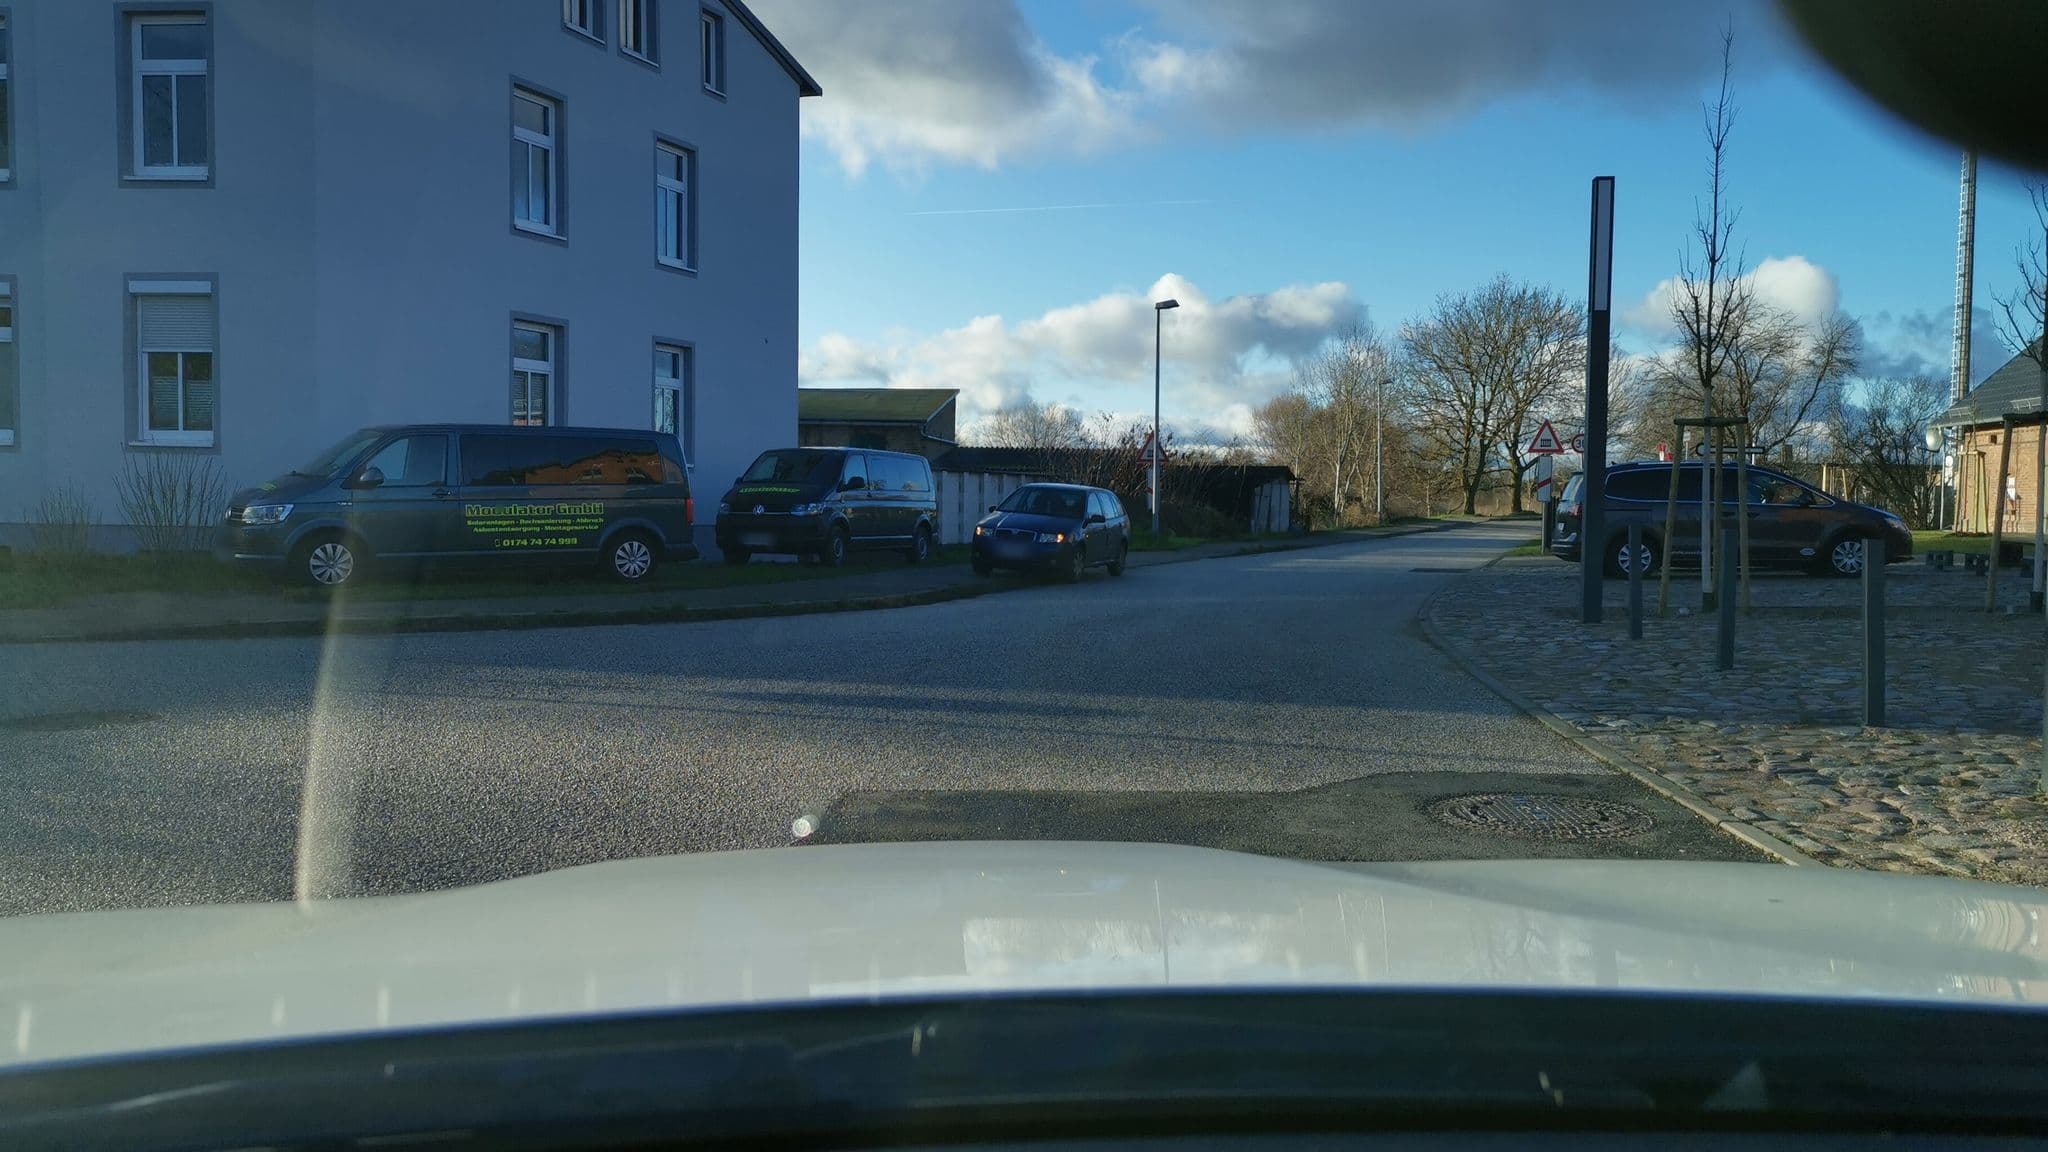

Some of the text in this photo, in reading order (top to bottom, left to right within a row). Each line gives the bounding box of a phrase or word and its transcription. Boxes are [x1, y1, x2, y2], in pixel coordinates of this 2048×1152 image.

[556, 503, 604, 515] GmbH
[529, 538, 542, 546] 74
[544, 538, 556, 546] 74
